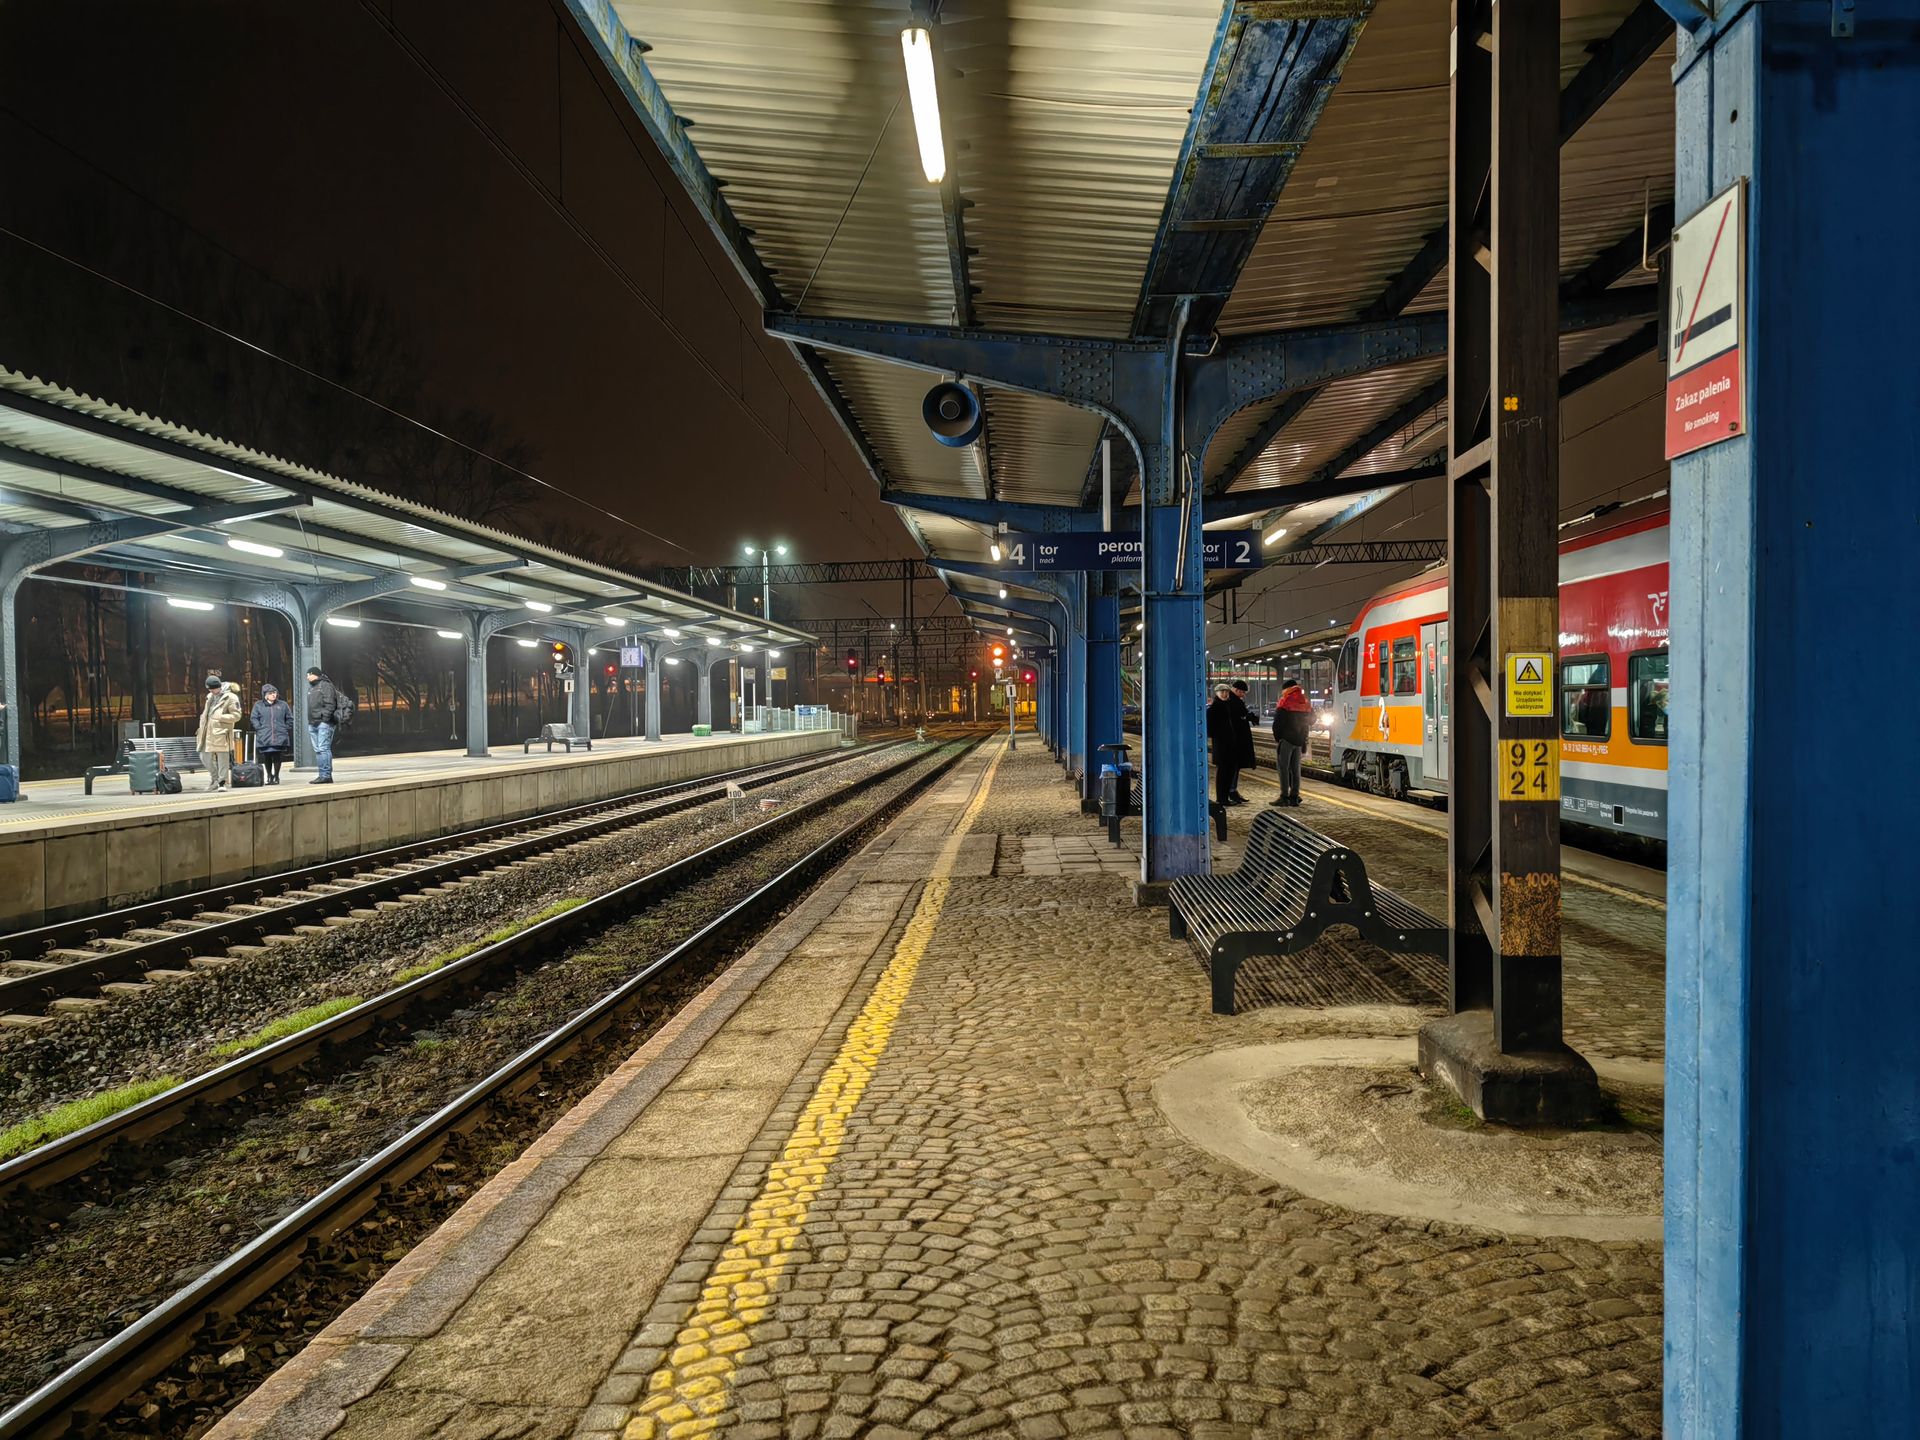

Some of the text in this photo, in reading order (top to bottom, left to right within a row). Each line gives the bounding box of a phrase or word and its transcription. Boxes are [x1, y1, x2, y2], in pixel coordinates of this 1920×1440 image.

[1675, 376, 1731, 412] Zakaz palenia
[1684, 411, 1720, 433] No smoking
[1009, 543, 1059, 566] 4 tor
[1098, 541, 1142, 556] peron
[1110, 554, 1142, 564] platform
[1202, 541, 1251, 563] tor 2
[1039, 556, 1055, 564] track
